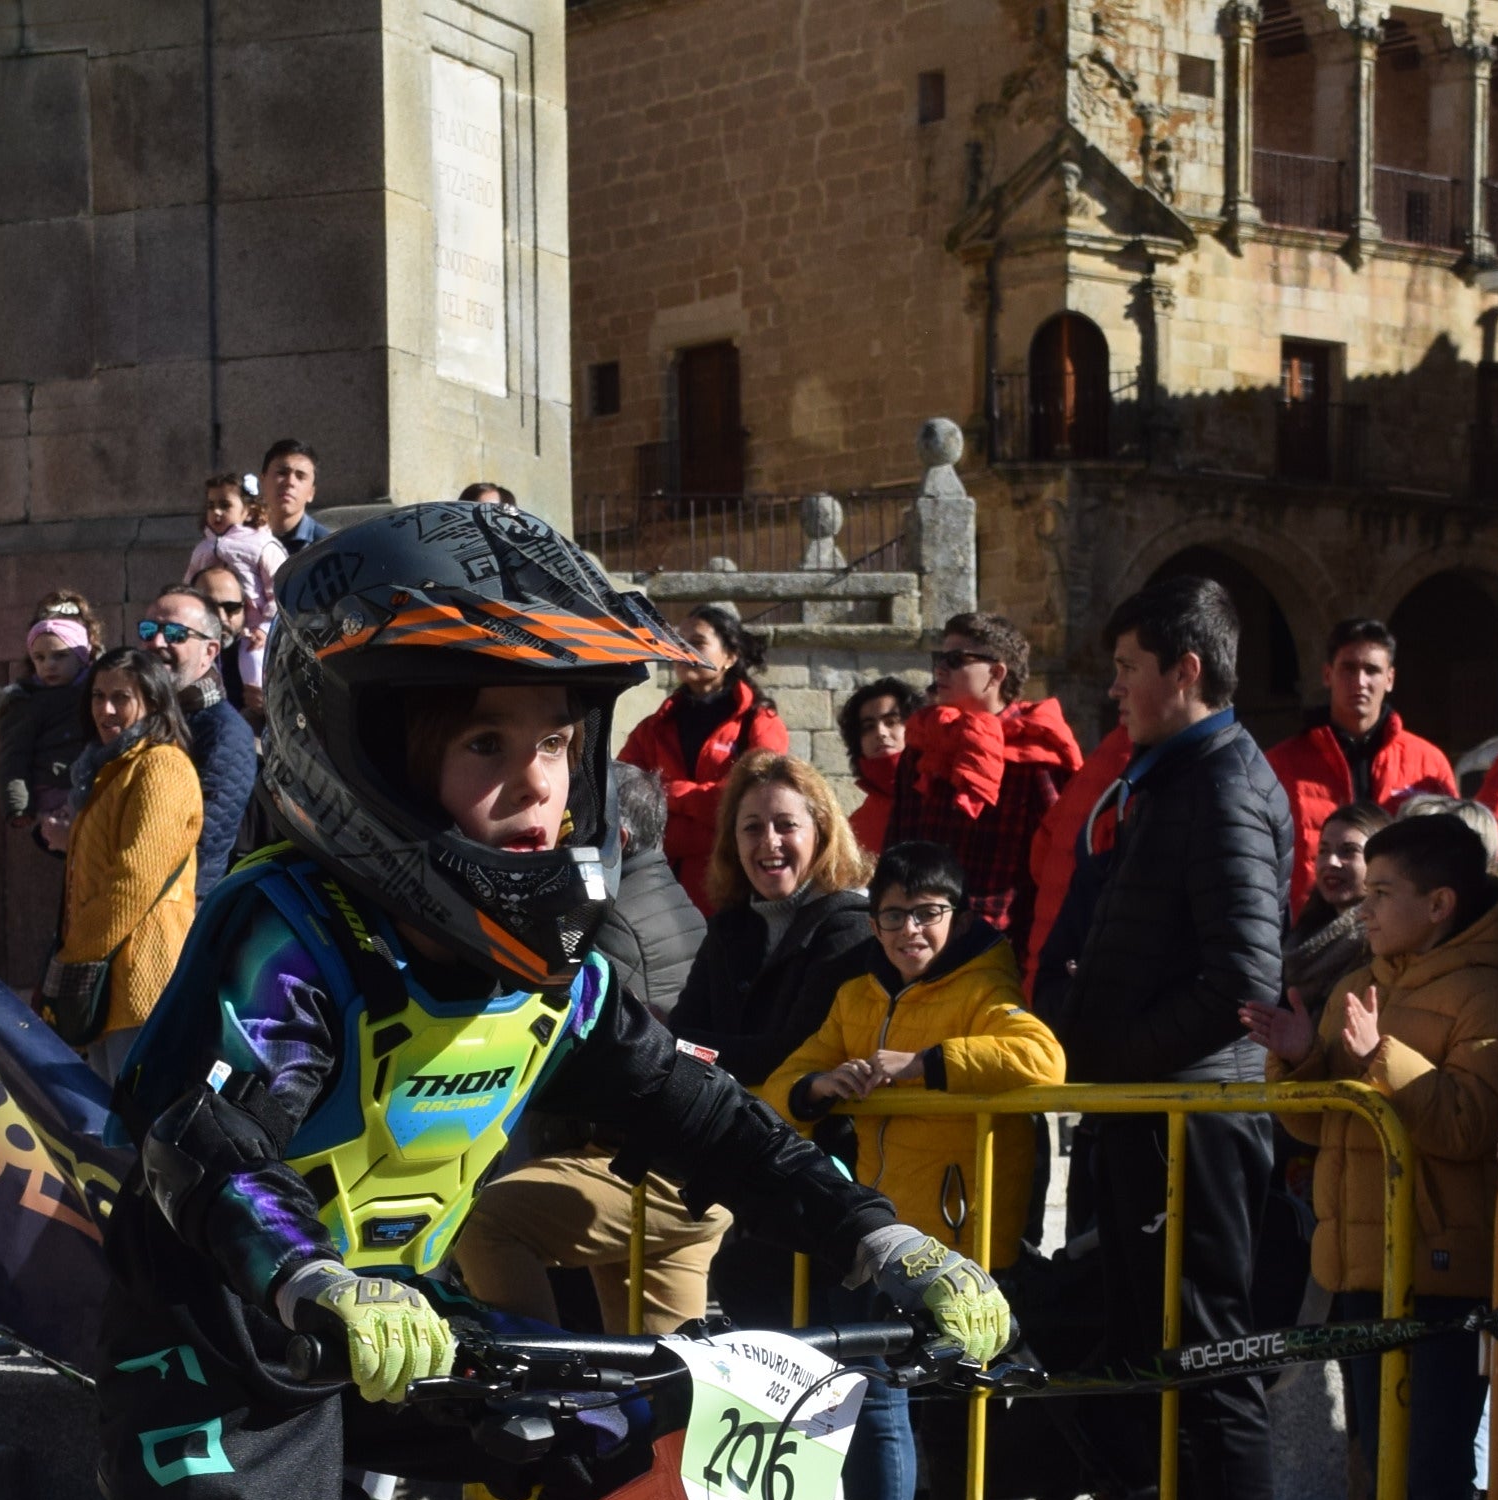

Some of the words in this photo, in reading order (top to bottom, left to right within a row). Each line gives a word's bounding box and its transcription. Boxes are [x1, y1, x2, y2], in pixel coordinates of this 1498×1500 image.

[437, 162, 495, 208] PIZARRO
[442, 290, 462, 319] DEL
[405, 1065, 516, 1098] THOR
[412, 1094, 495, 1113] RACING
[742, 1343, 789, 1374] ENDURO
[1180, 1332, 1286, 1370] #DEPORTE
[765, 1380, 791, 1406] 2023
